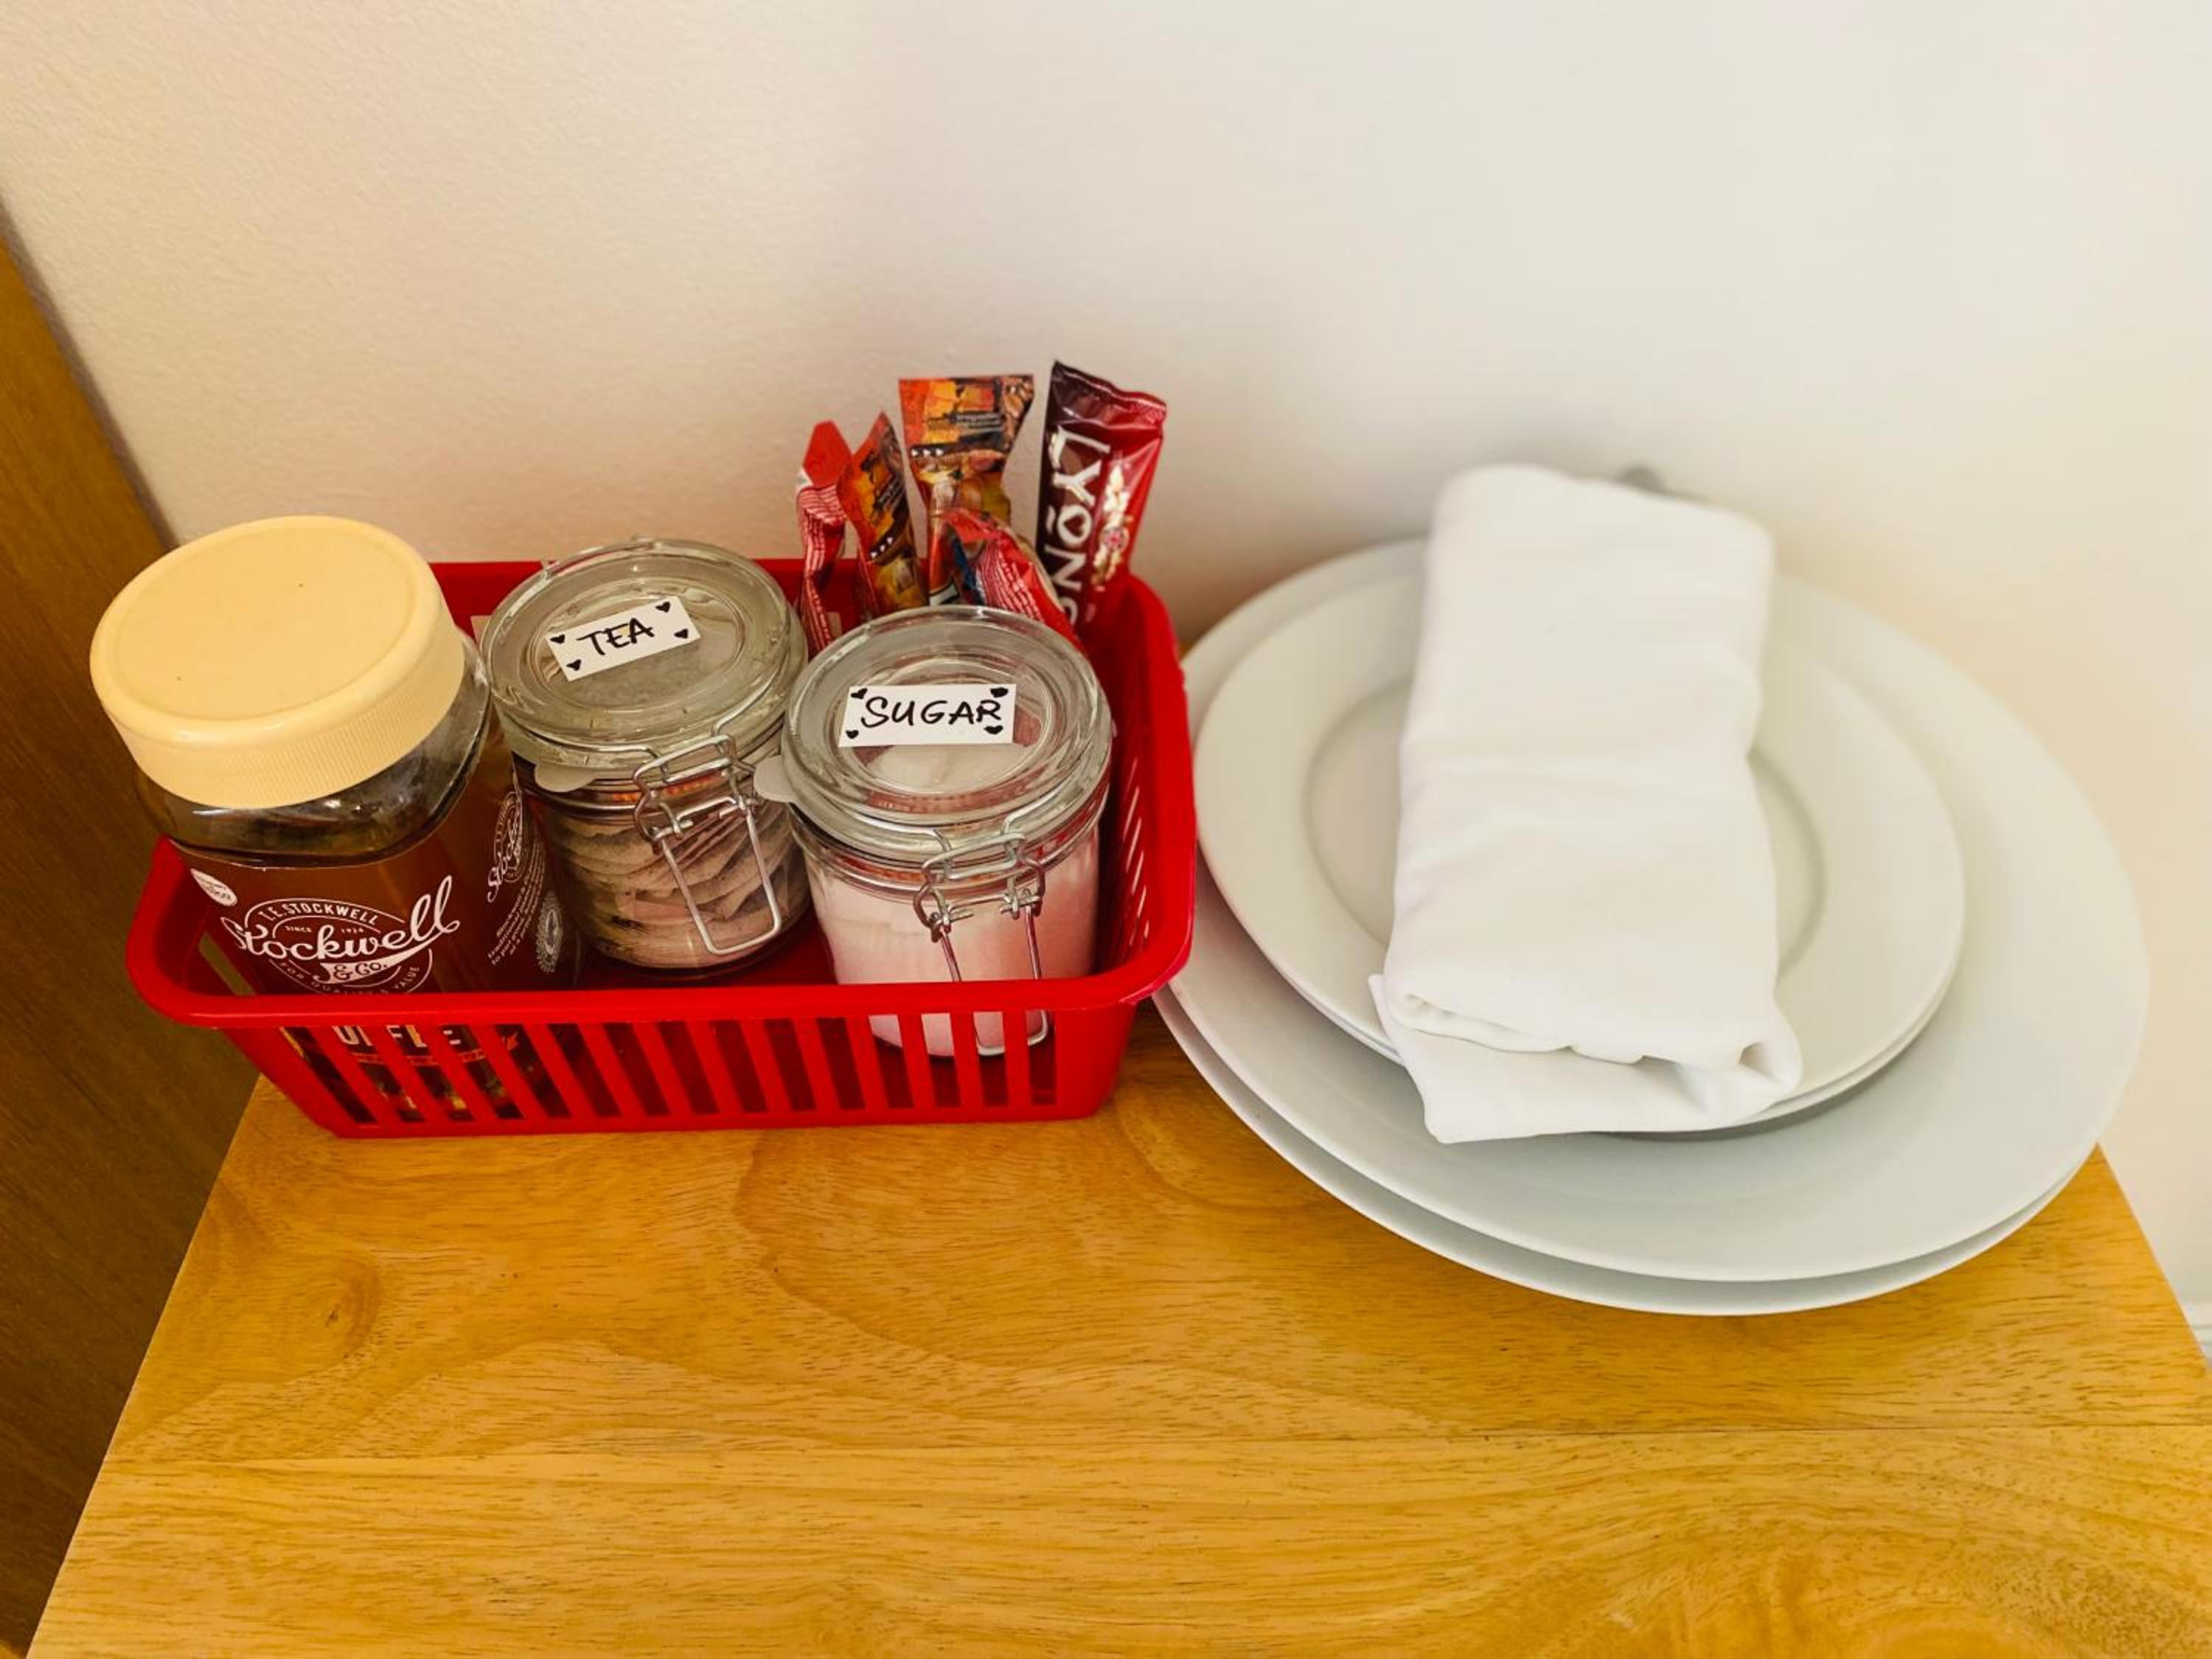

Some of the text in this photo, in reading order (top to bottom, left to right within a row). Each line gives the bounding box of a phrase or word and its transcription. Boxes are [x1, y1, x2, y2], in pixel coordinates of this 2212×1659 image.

[576, 617, 655, 655] TEA
[860, 696, 1002, 728] SUGAR
[220, 872, 461, 961] Stockwell
[282, 902, 378, 925] STOCKWELL
[333, 963, 353, 981] &
